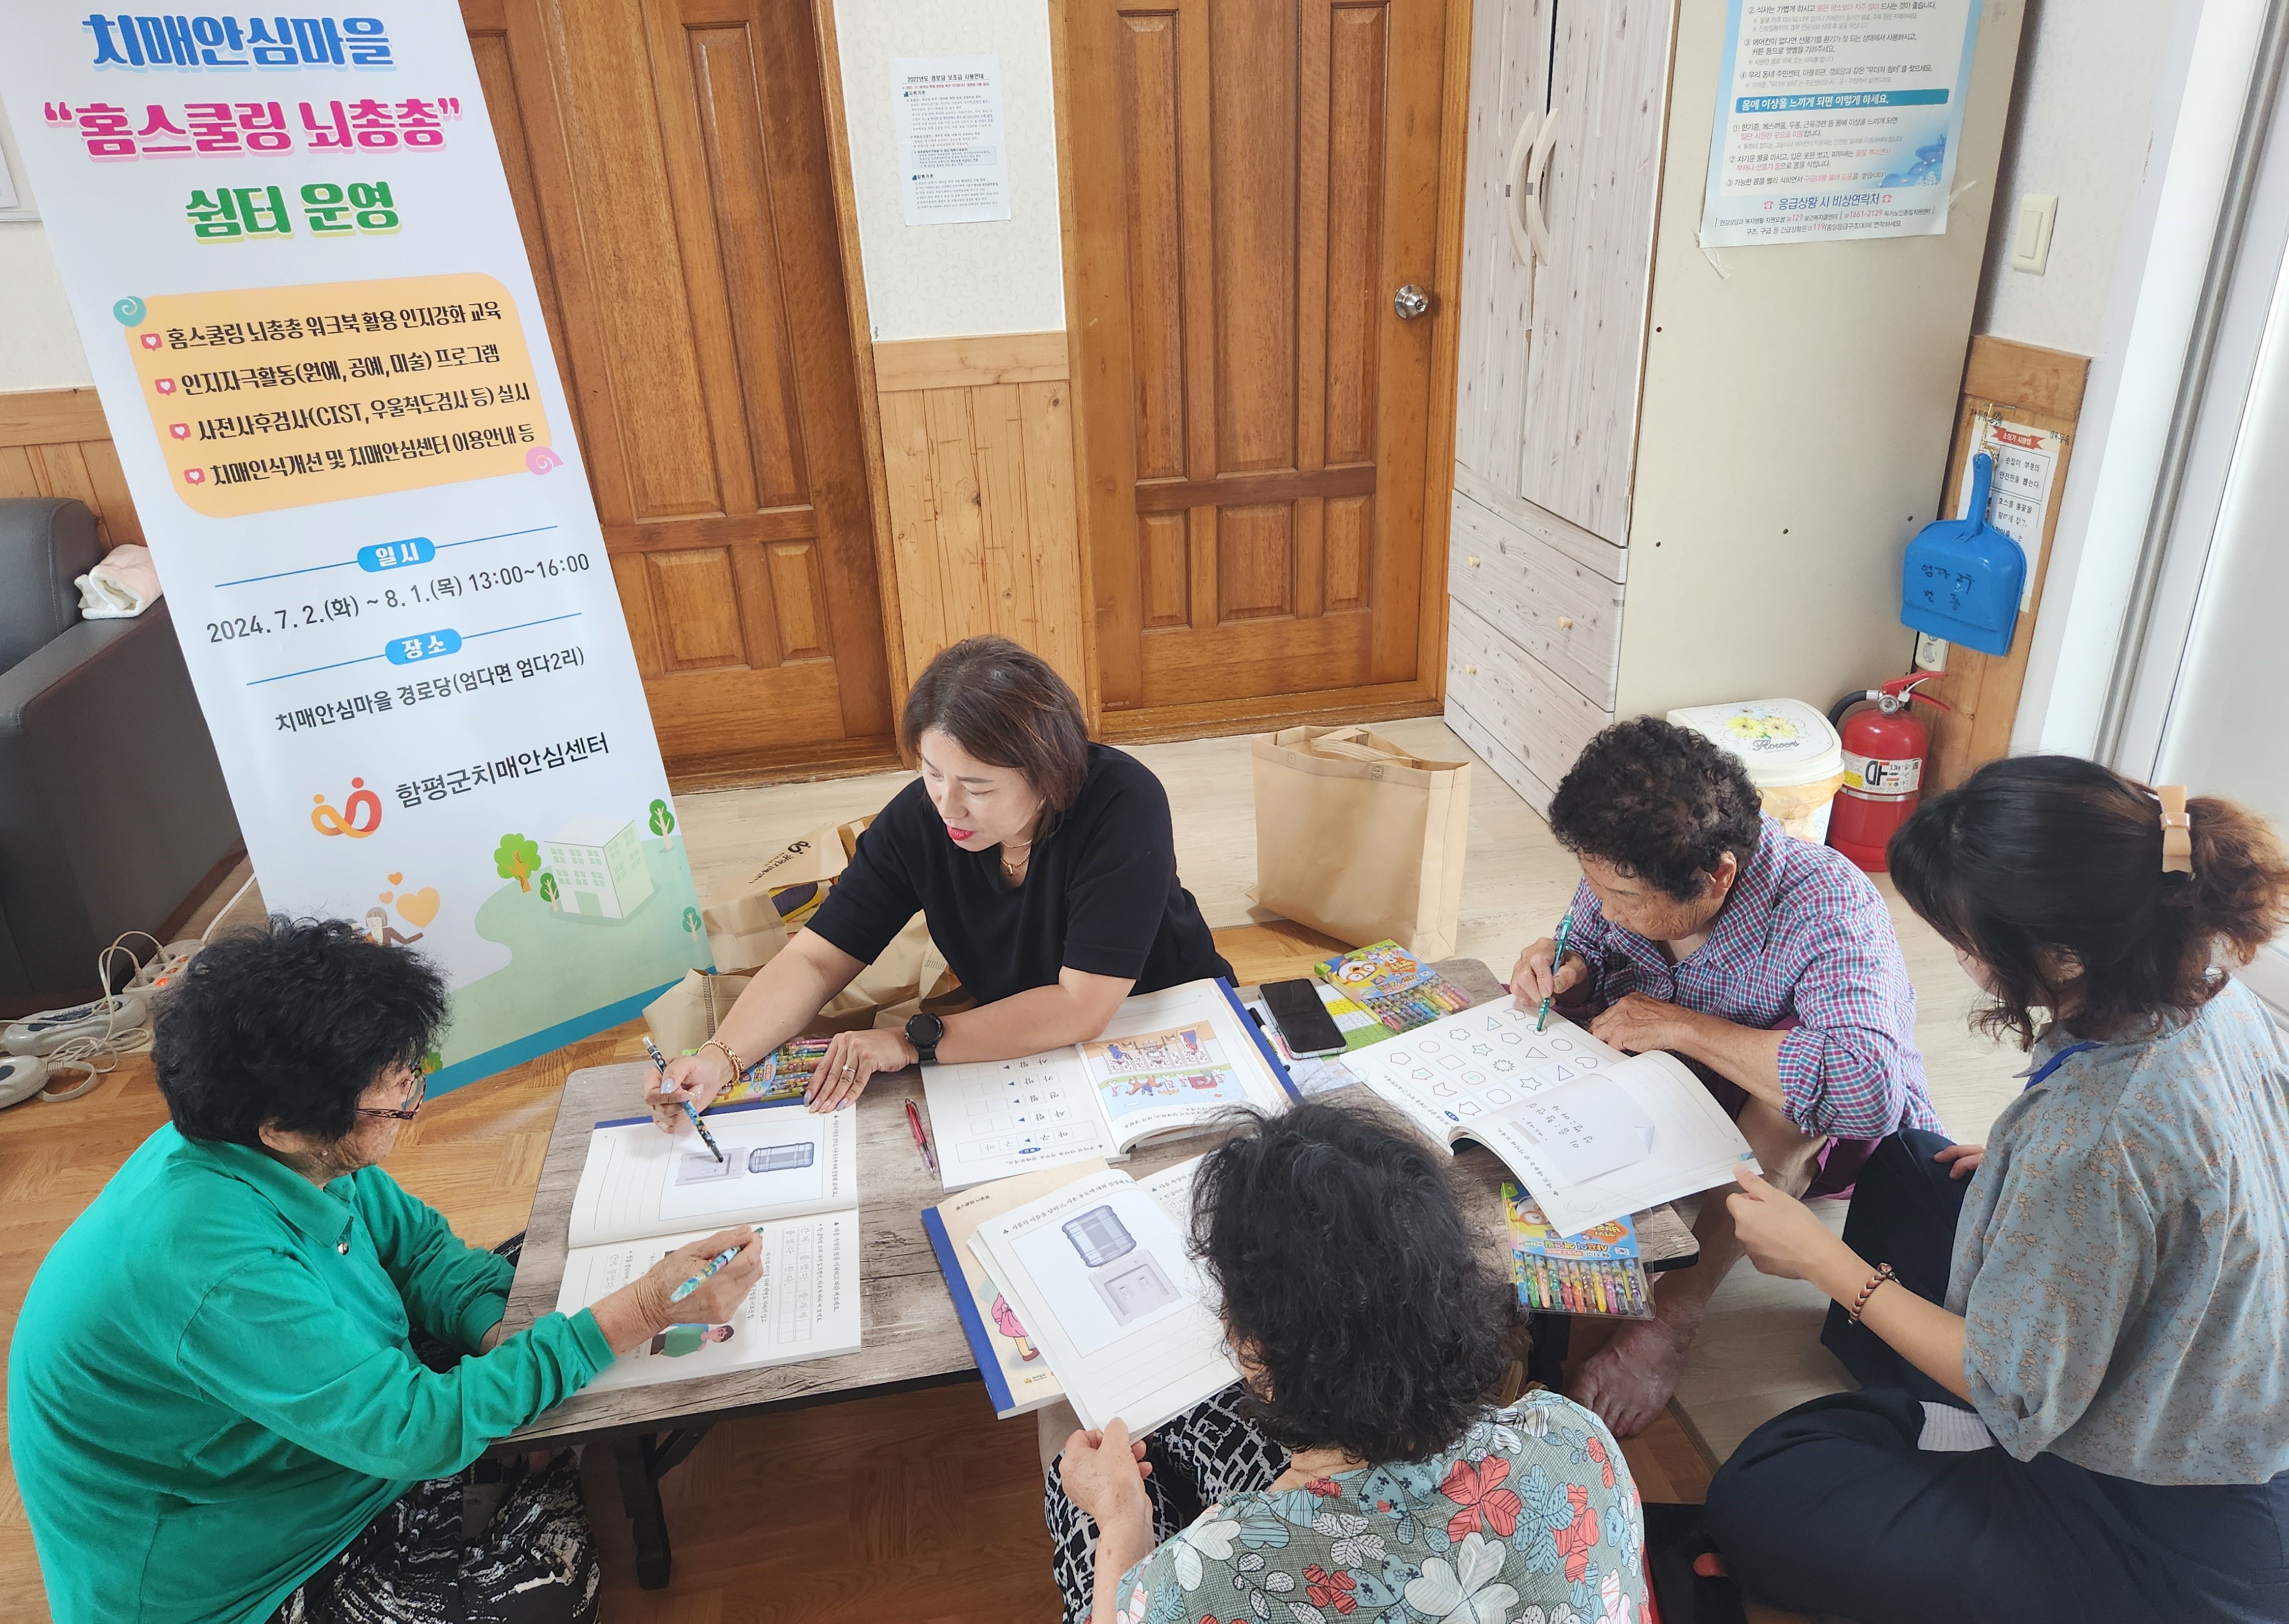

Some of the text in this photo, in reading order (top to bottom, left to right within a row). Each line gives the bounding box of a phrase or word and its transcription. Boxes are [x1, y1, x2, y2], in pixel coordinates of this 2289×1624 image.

[83, 13, 397, 71] 치매안심마을
[1763, 70, 1774, 78] 동네
[45, 97, 462, 161] “홈스쿨링 뇌총총”
[1742, 94, 1888, 111] 몸에 이상을 느끼게 되면 이렇게 하세요.
[187, 181, 401, 243] 쉼터 운영
[1779, 193, 1880, 210] 응급상황 시 비상연락처
[166, 301, 502, 350] 홈스쿨링 뇌총총 워크북 활용 인지강화 교육
[181, 343, 500, 397] 인지자극활동(원예, 공예, 미술) 프로그램
[199, 382, 530, 442] 사전사후검사(CIST, 우울척도검사 등) 실시
[210, 423, 535, 487] 치매인식개선 및 치매안심센터 이용안내 등
[1999, 471, 2039, 488] 안전핀을 뽑는다.
[2006, 457, 2039, 472] 손잡이 부분의
[1998, 498, 2032, 514] 호스를 불꽃을
[206, 615, 272, 643] 2024.
[275, 610, 298, 630] 7.
[385, 590, 406, 609] 8.
[469, 553, 590, 592] 13:00~16:00
[275, 647, 585, 734] 치매안심마을 경로당(엄다면 엄다2리)
[396, 732, 610, 809] 함평군치매안심센터
[1753, 739, 1800, 751] Flowers
